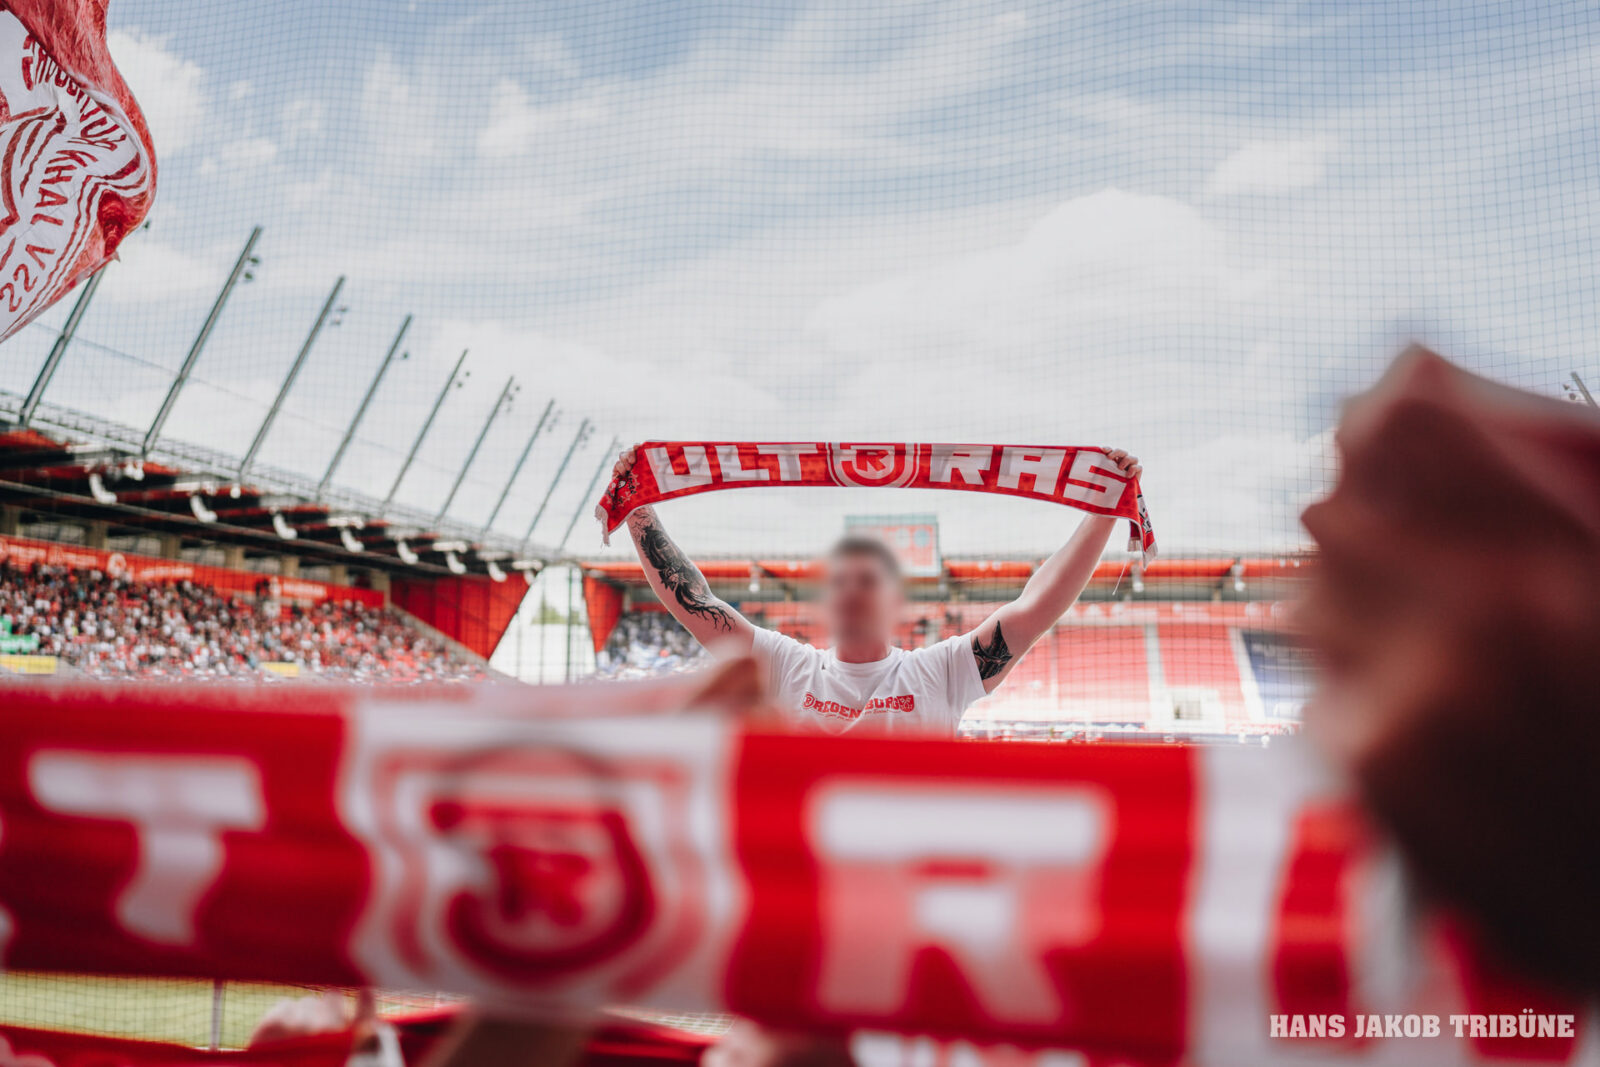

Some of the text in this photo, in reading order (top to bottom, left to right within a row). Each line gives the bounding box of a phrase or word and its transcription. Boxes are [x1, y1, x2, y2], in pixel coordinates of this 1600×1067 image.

[645, 443, 818, 494] ULT
[929, 444, 1128, 509] RAS
[813, 696, 899, 719] REGENBURG
